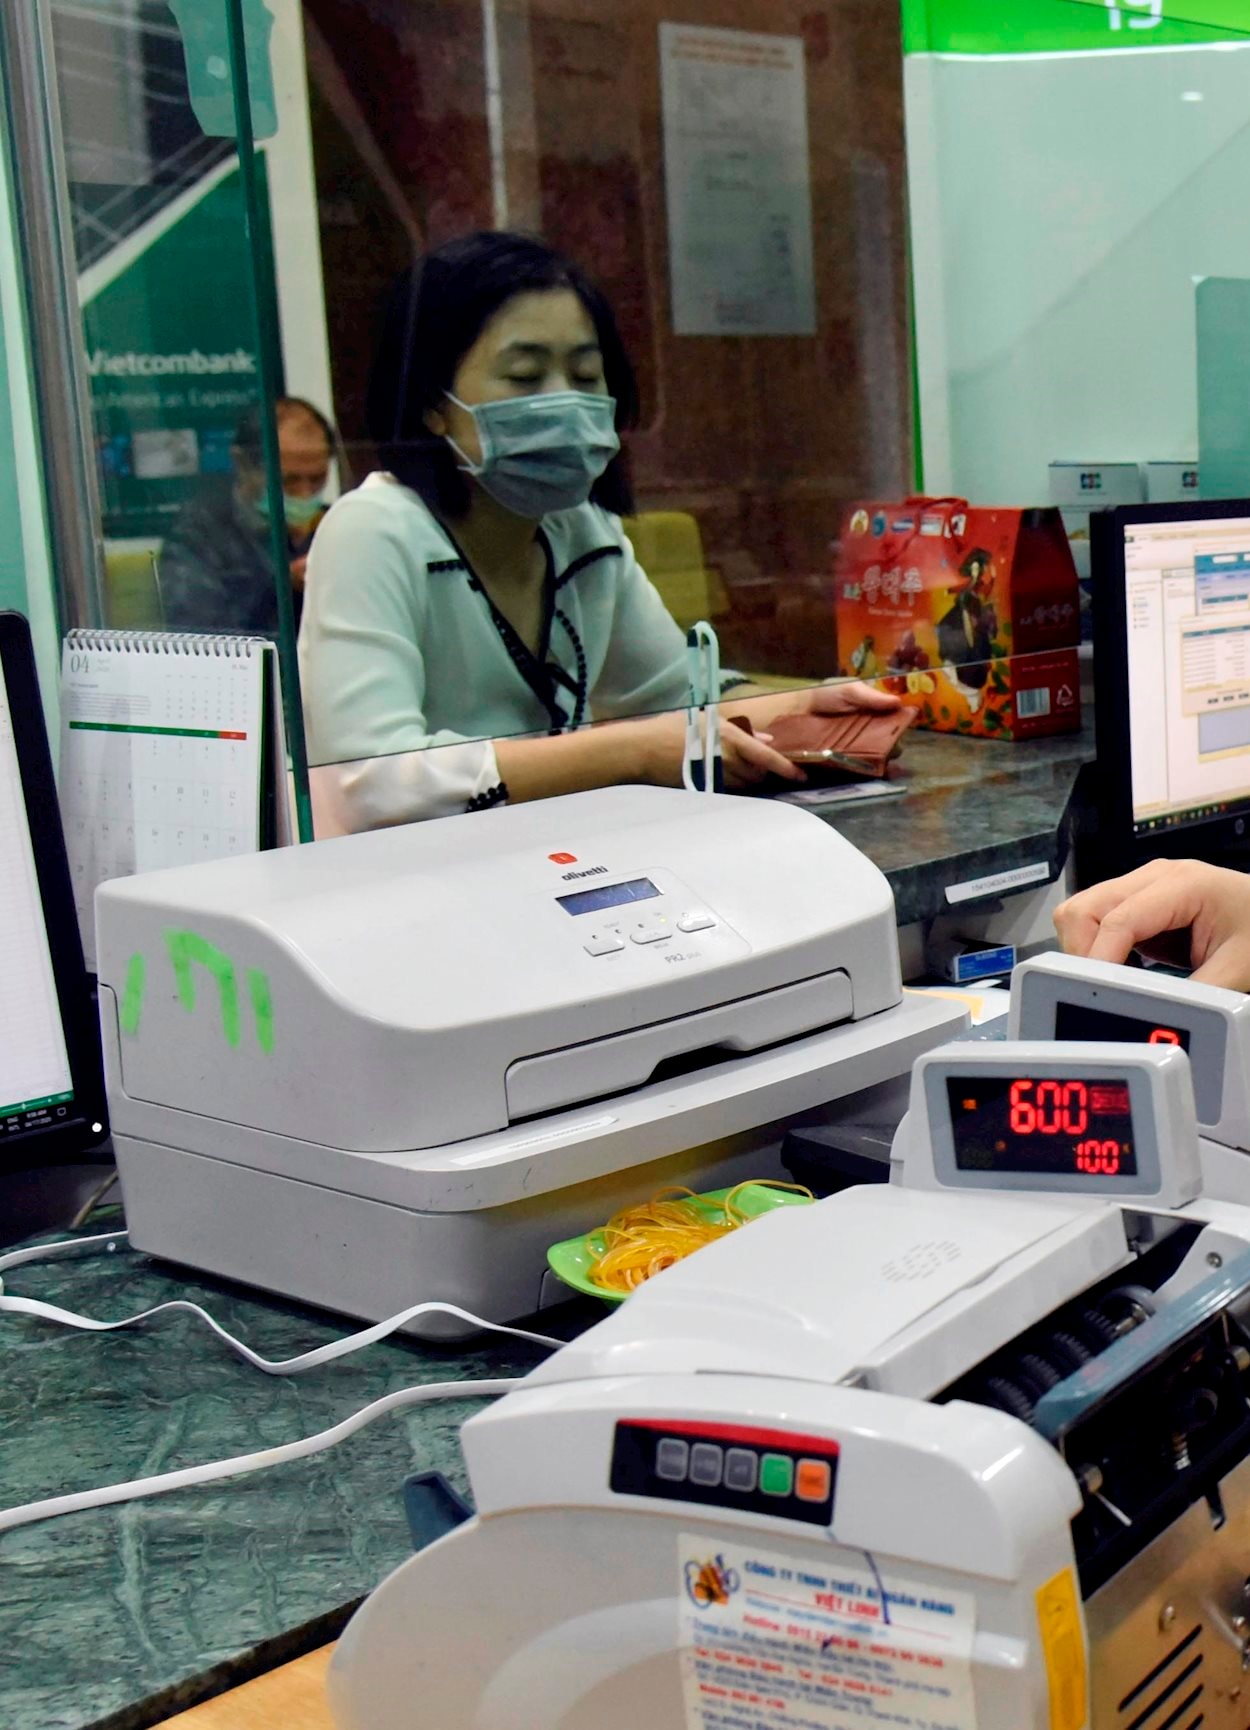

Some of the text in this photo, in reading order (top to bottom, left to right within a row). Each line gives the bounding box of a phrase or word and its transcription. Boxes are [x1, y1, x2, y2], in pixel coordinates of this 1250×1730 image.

[85, 348, 257, 377] Vietcombank
[70, 654, 90, 674] 04
[561, 865, 609, 882] olivetti
[1010, 1080, 1088, 1135] 600
[1076, 1139, 1120, 1175] 100
[815, 1592, 843, 1612] VIỆT
